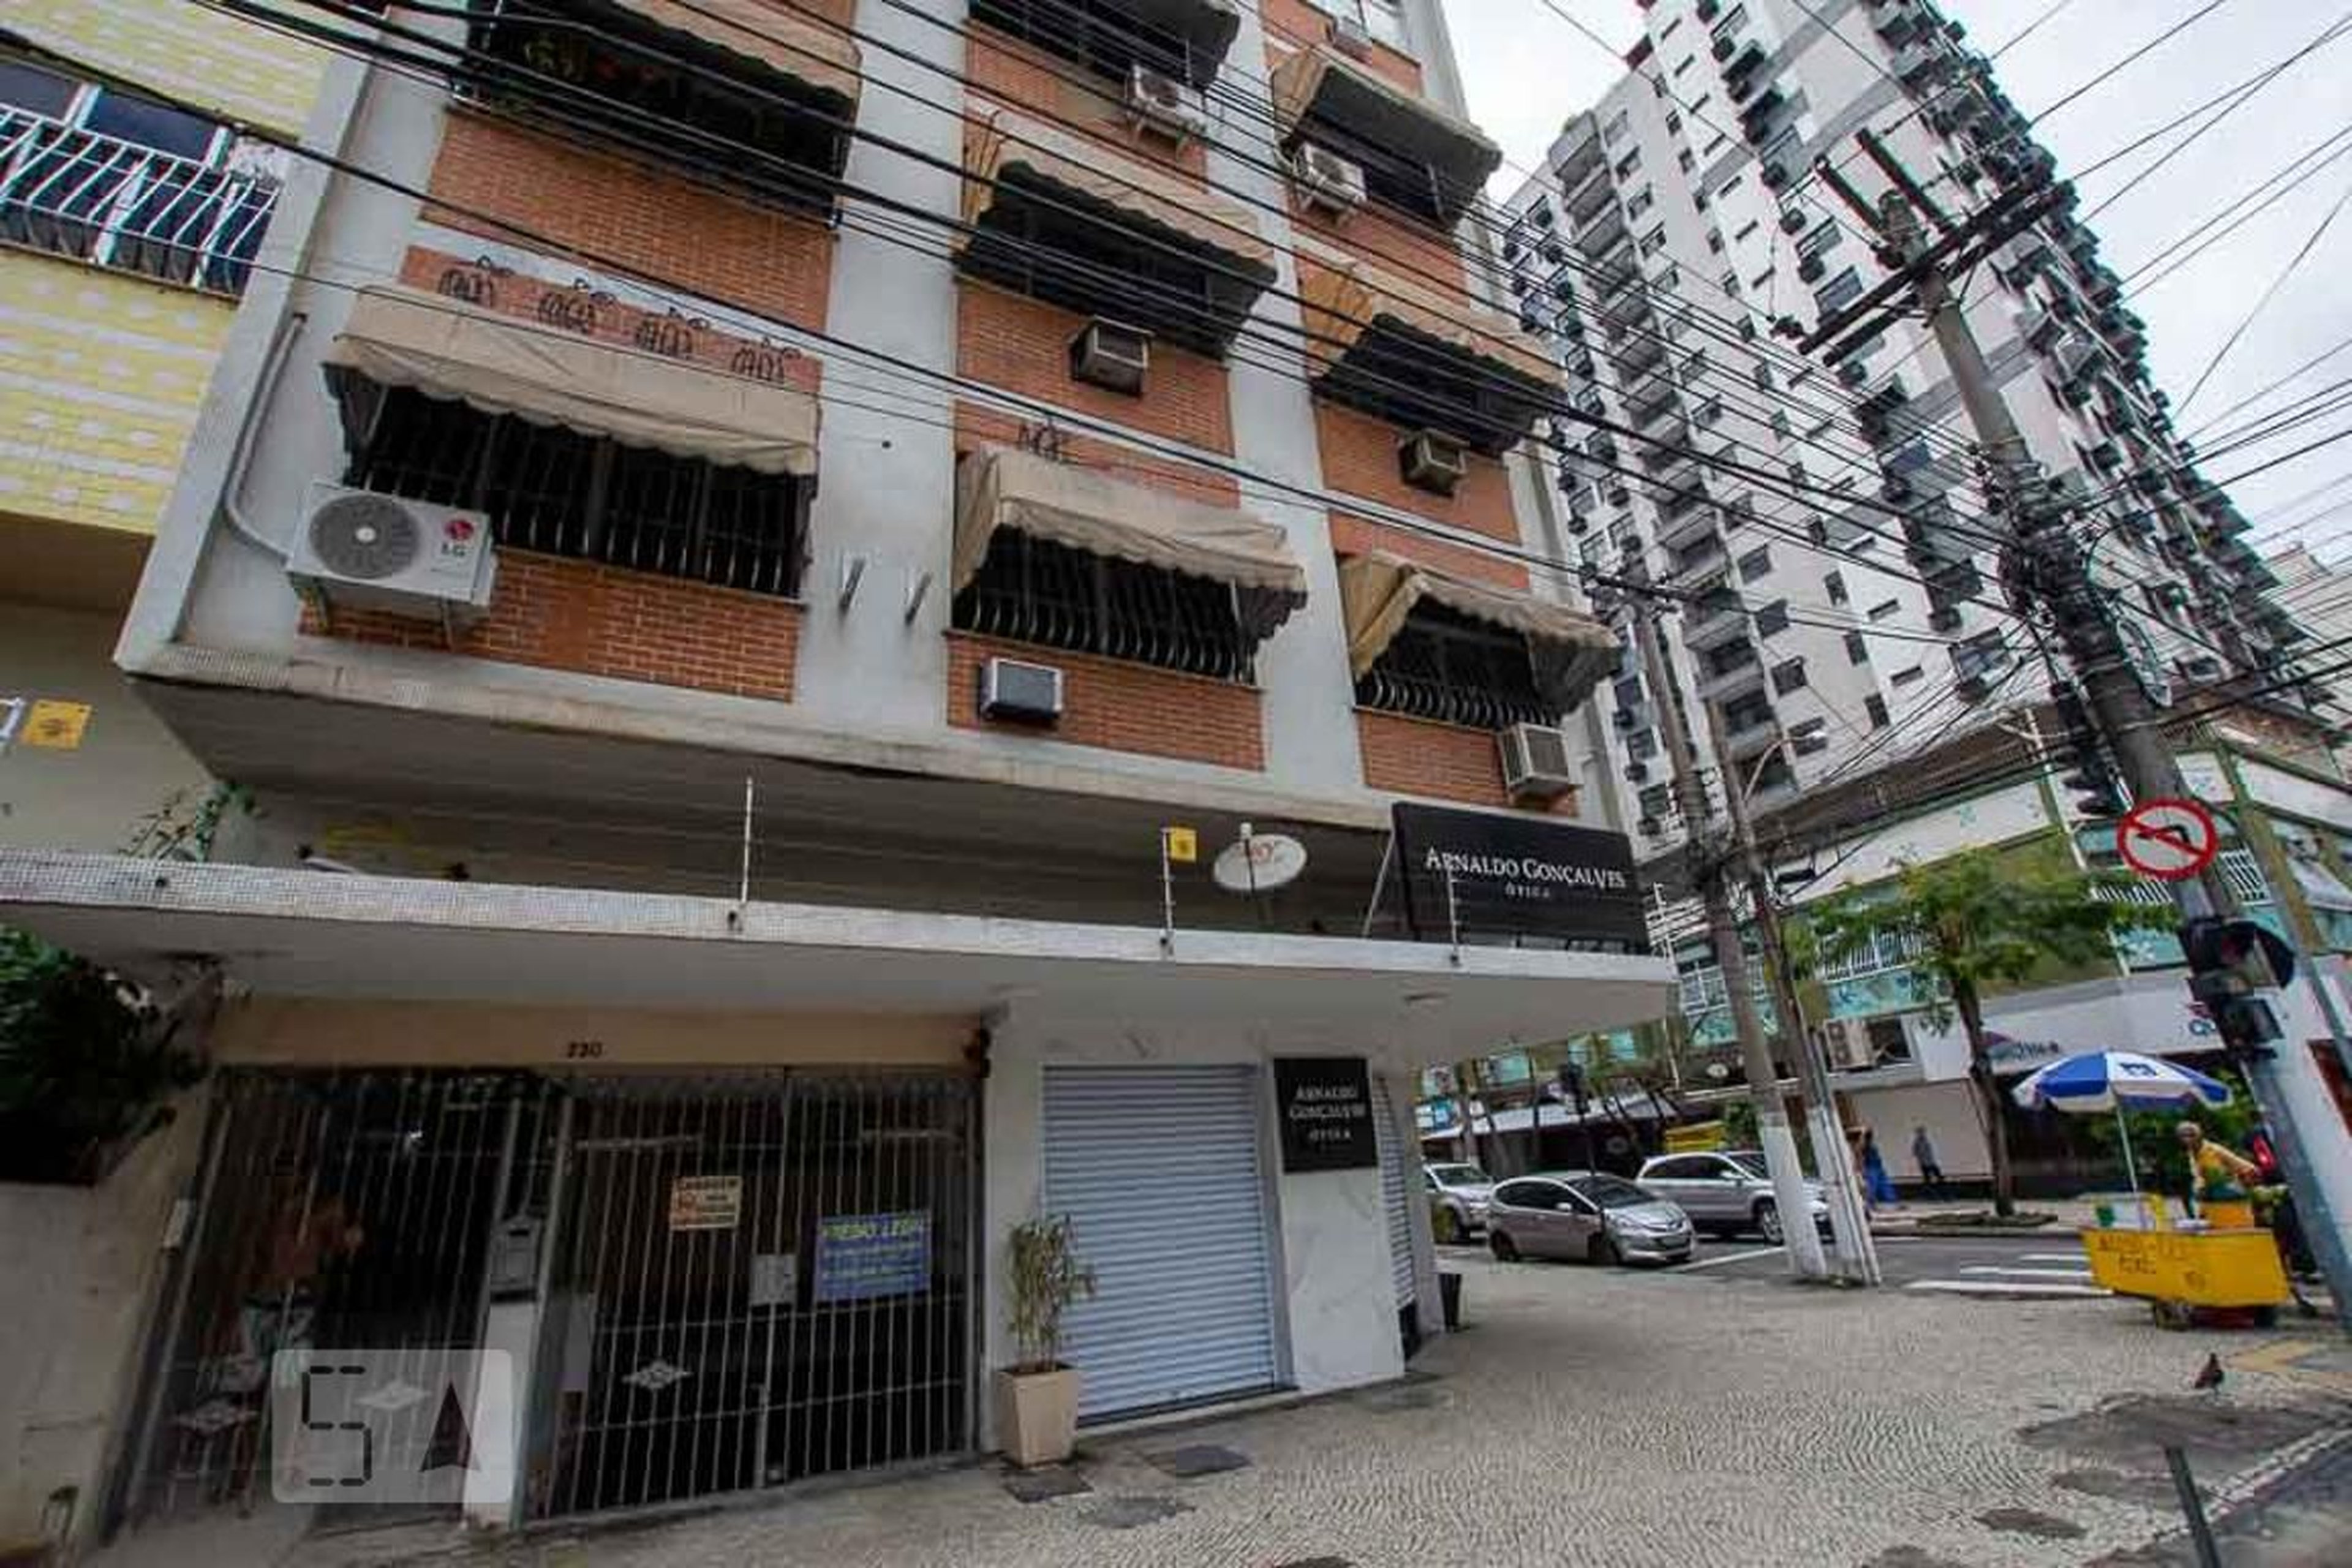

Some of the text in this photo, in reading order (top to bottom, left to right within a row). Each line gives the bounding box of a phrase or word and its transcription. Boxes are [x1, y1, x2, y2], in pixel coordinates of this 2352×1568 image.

[441, 542, 466, 558] LG
[1425, 846, 1627, 889] ARNALDO GONÇALVES
